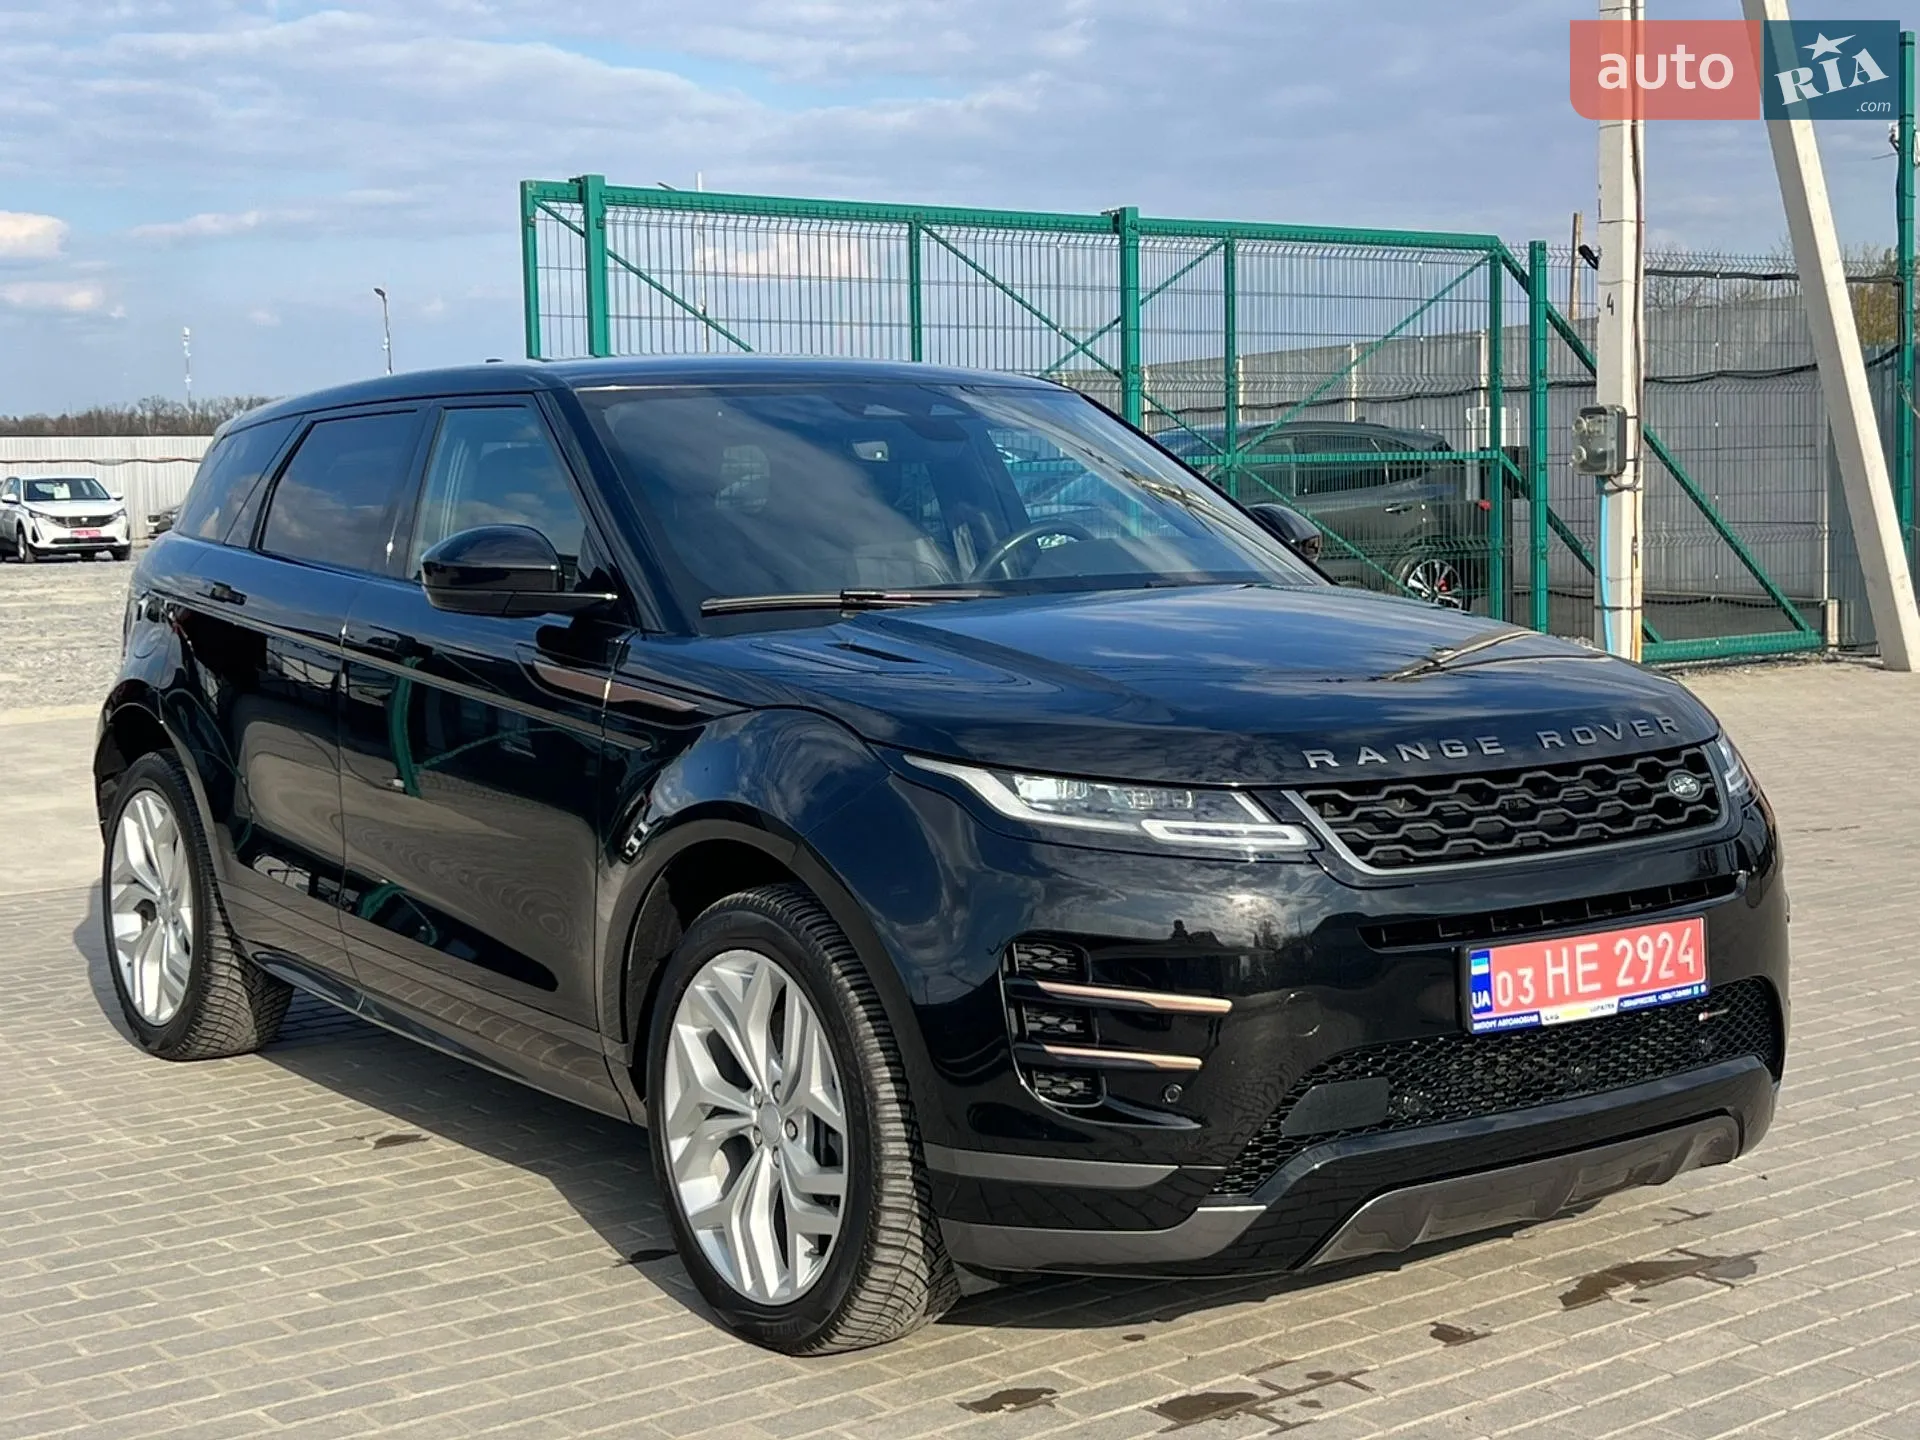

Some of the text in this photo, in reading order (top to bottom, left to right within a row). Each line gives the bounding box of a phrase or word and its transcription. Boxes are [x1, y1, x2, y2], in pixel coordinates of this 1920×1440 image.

[1606, 291, 1615, 316] 4
[1302, 716, 1681, 769] RANGE ROVER
[1496, 927, 1696, 1008] 03 HE 2924
[1472, 991, 1491, 1008] UA
